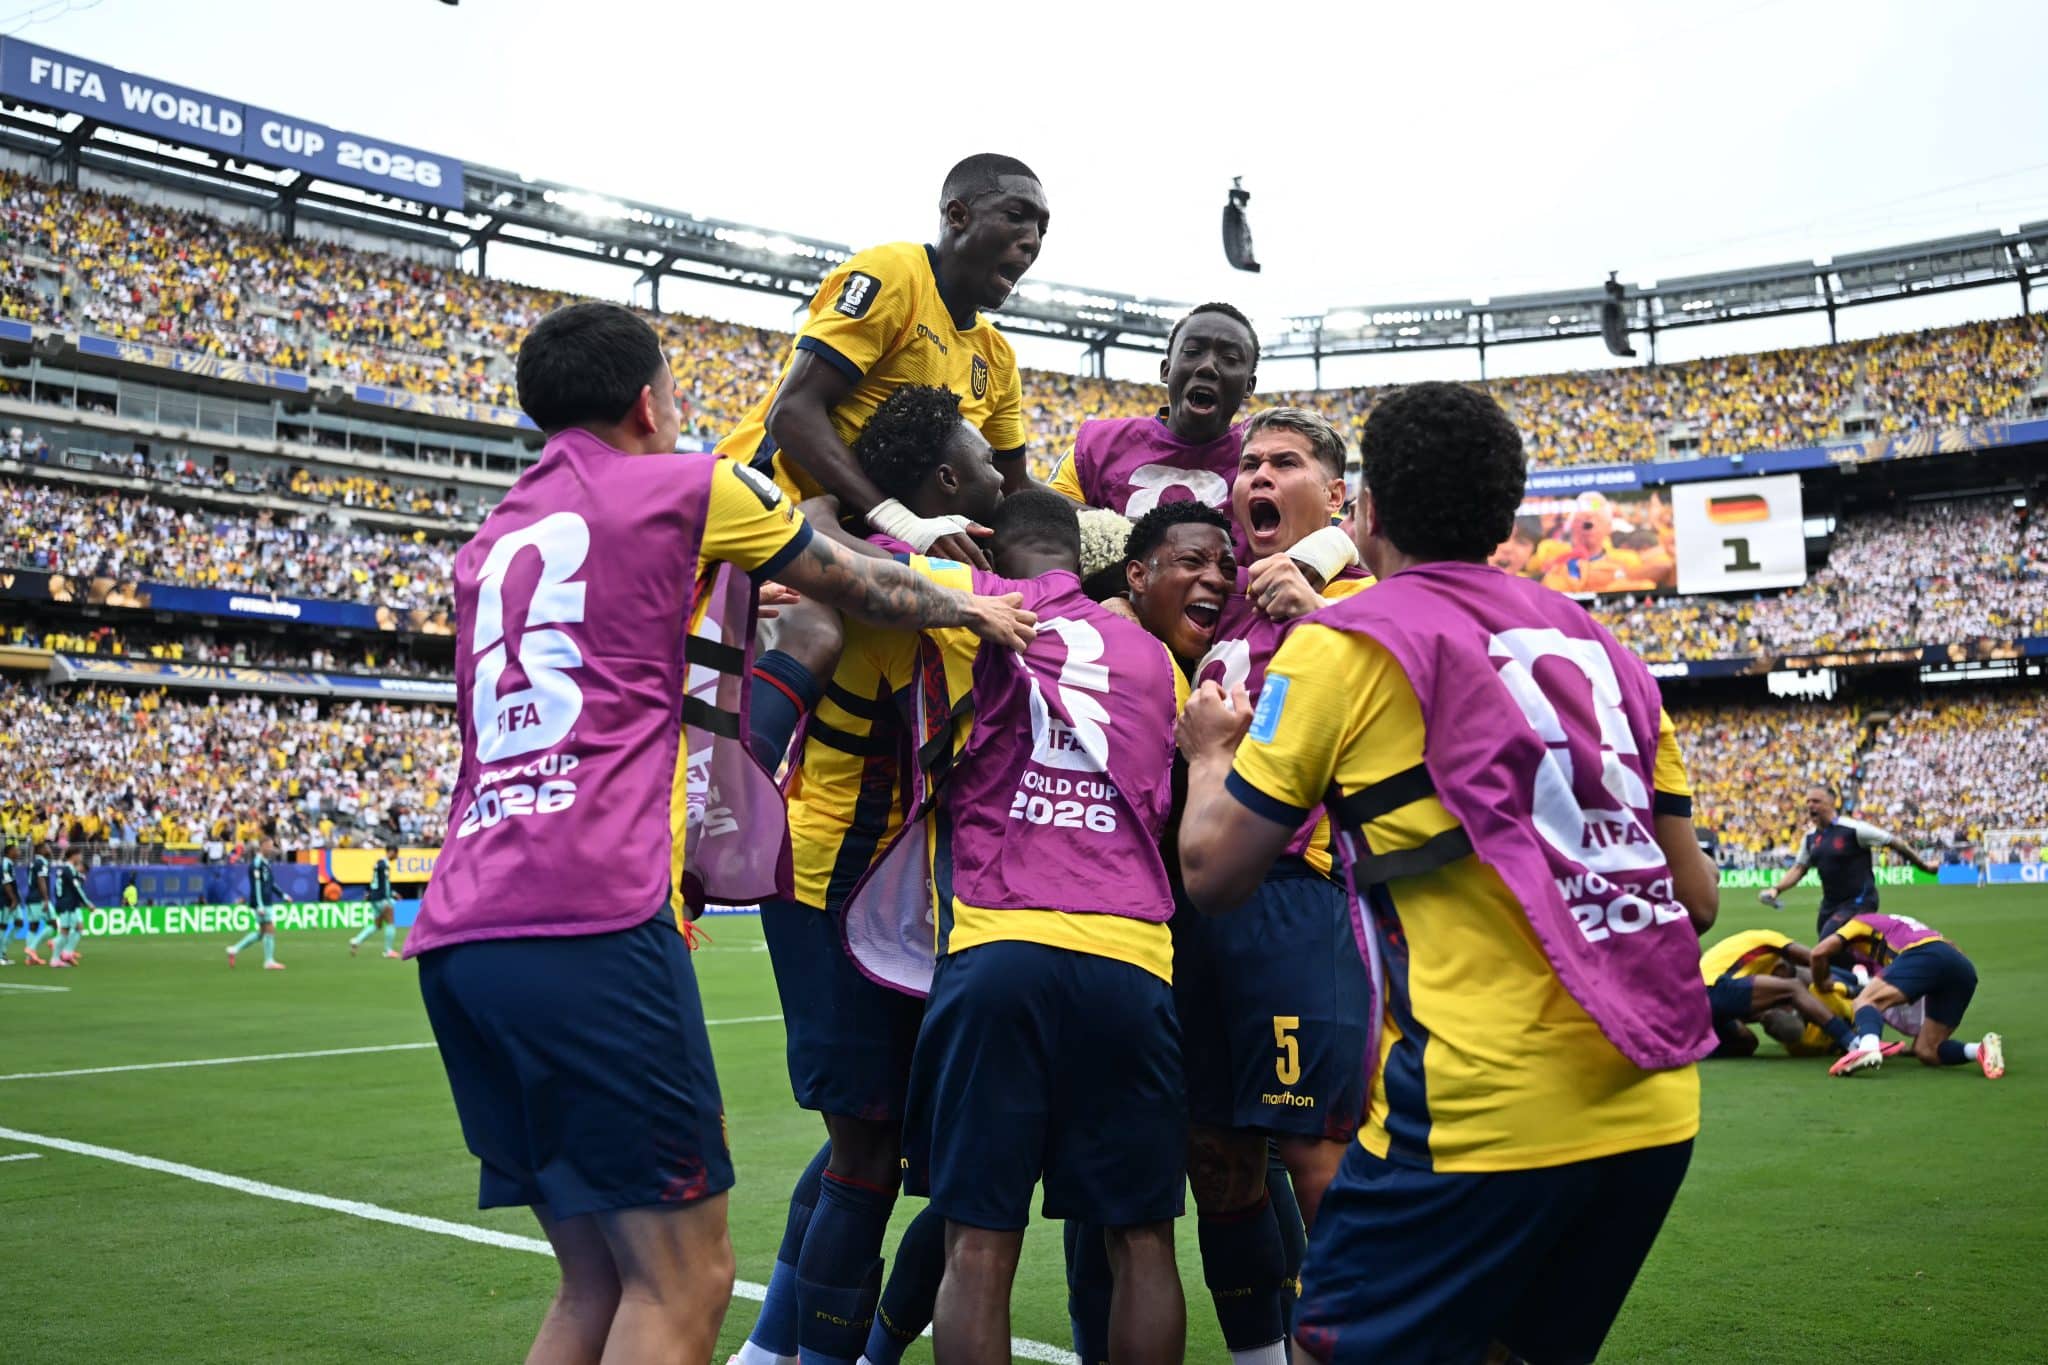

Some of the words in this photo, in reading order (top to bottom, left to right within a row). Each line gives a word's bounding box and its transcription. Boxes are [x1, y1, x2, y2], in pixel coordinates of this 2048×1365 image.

[29, 56, 106, 102] FIFA
[120, 82, 242, 137] WORLD
[261, 121, 324, 157] CUP
[336, 141, 442, 188] 2026
[1723, 538, 1762, 572] 1
[1048, 728, 1087, 754] IFA
[1019, 770, 1071, 796] ORLD
[1076, 781, 1118, 801] CUP
[456, 780, 577, 839] 2026
[1009, 791, 1116, 833] 2026
[397, 857, 435, 873] ECU
[81, 907, 160, 936] OBAL
[1273, 1015, 1301, 1086] 5
